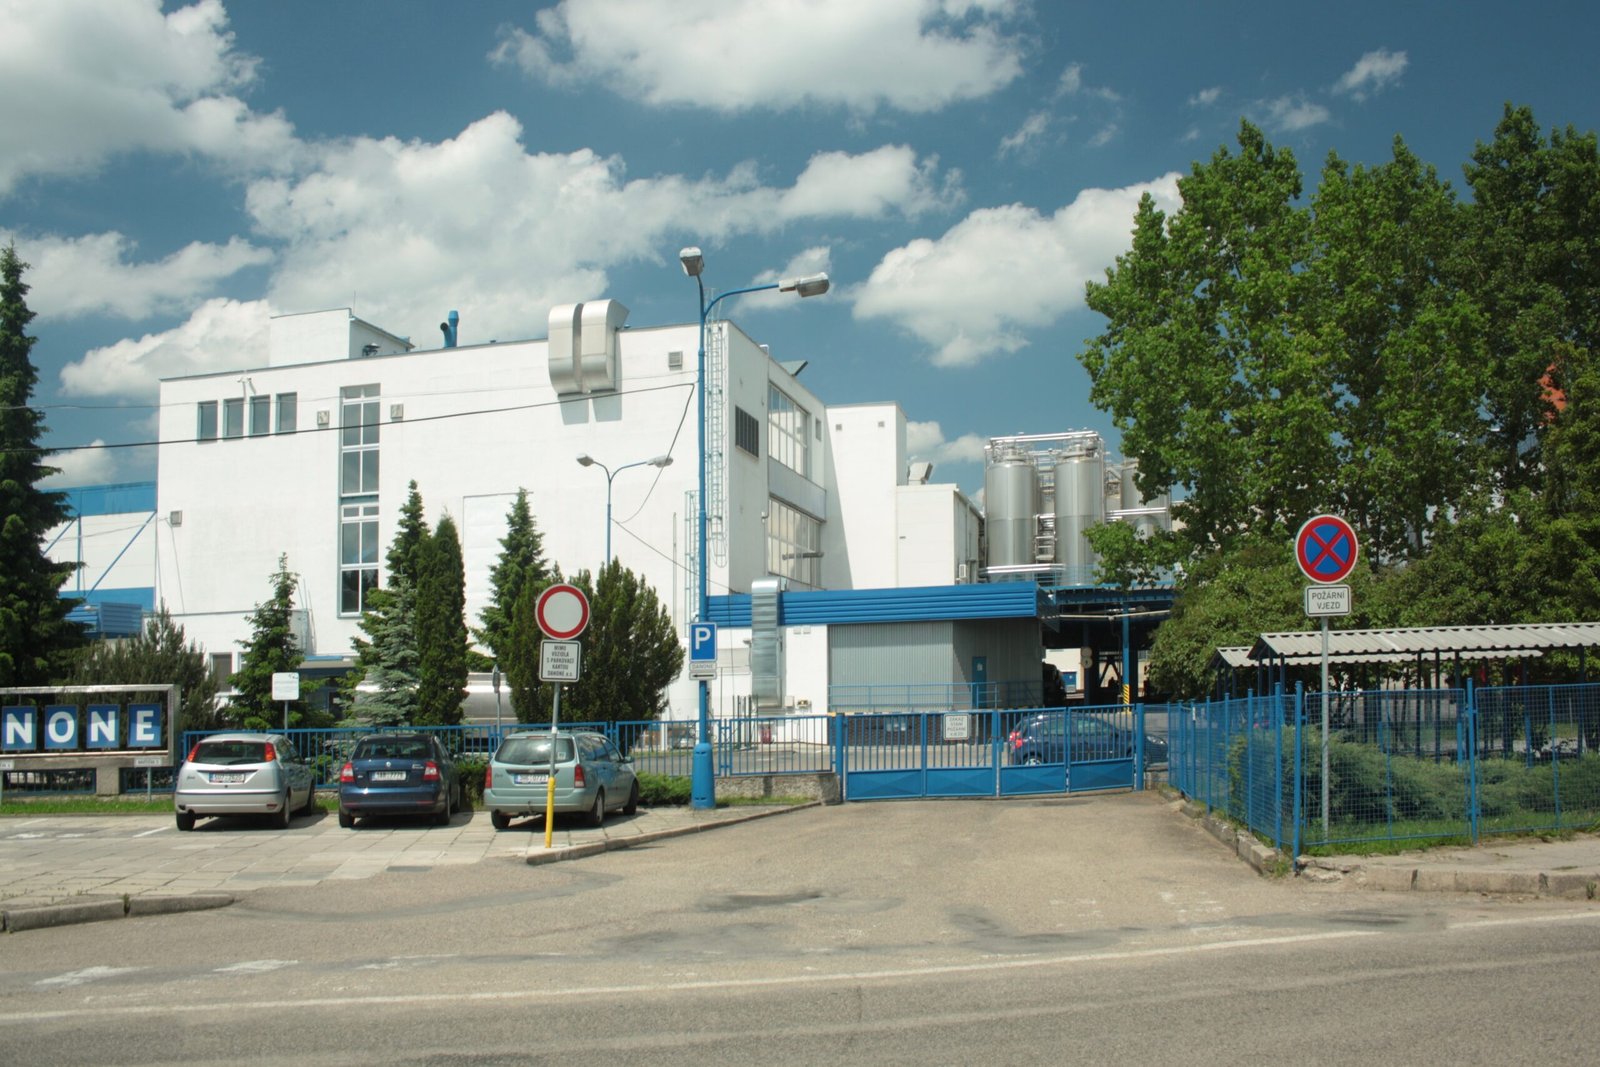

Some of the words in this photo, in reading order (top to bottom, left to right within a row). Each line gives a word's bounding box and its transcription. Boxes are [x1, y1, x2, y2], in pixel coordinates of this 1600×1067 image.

[1316, 602, 1341, 610] VJEZD
[695, 627, 711, 650] P
[6, 710, 155, 744] NONE
